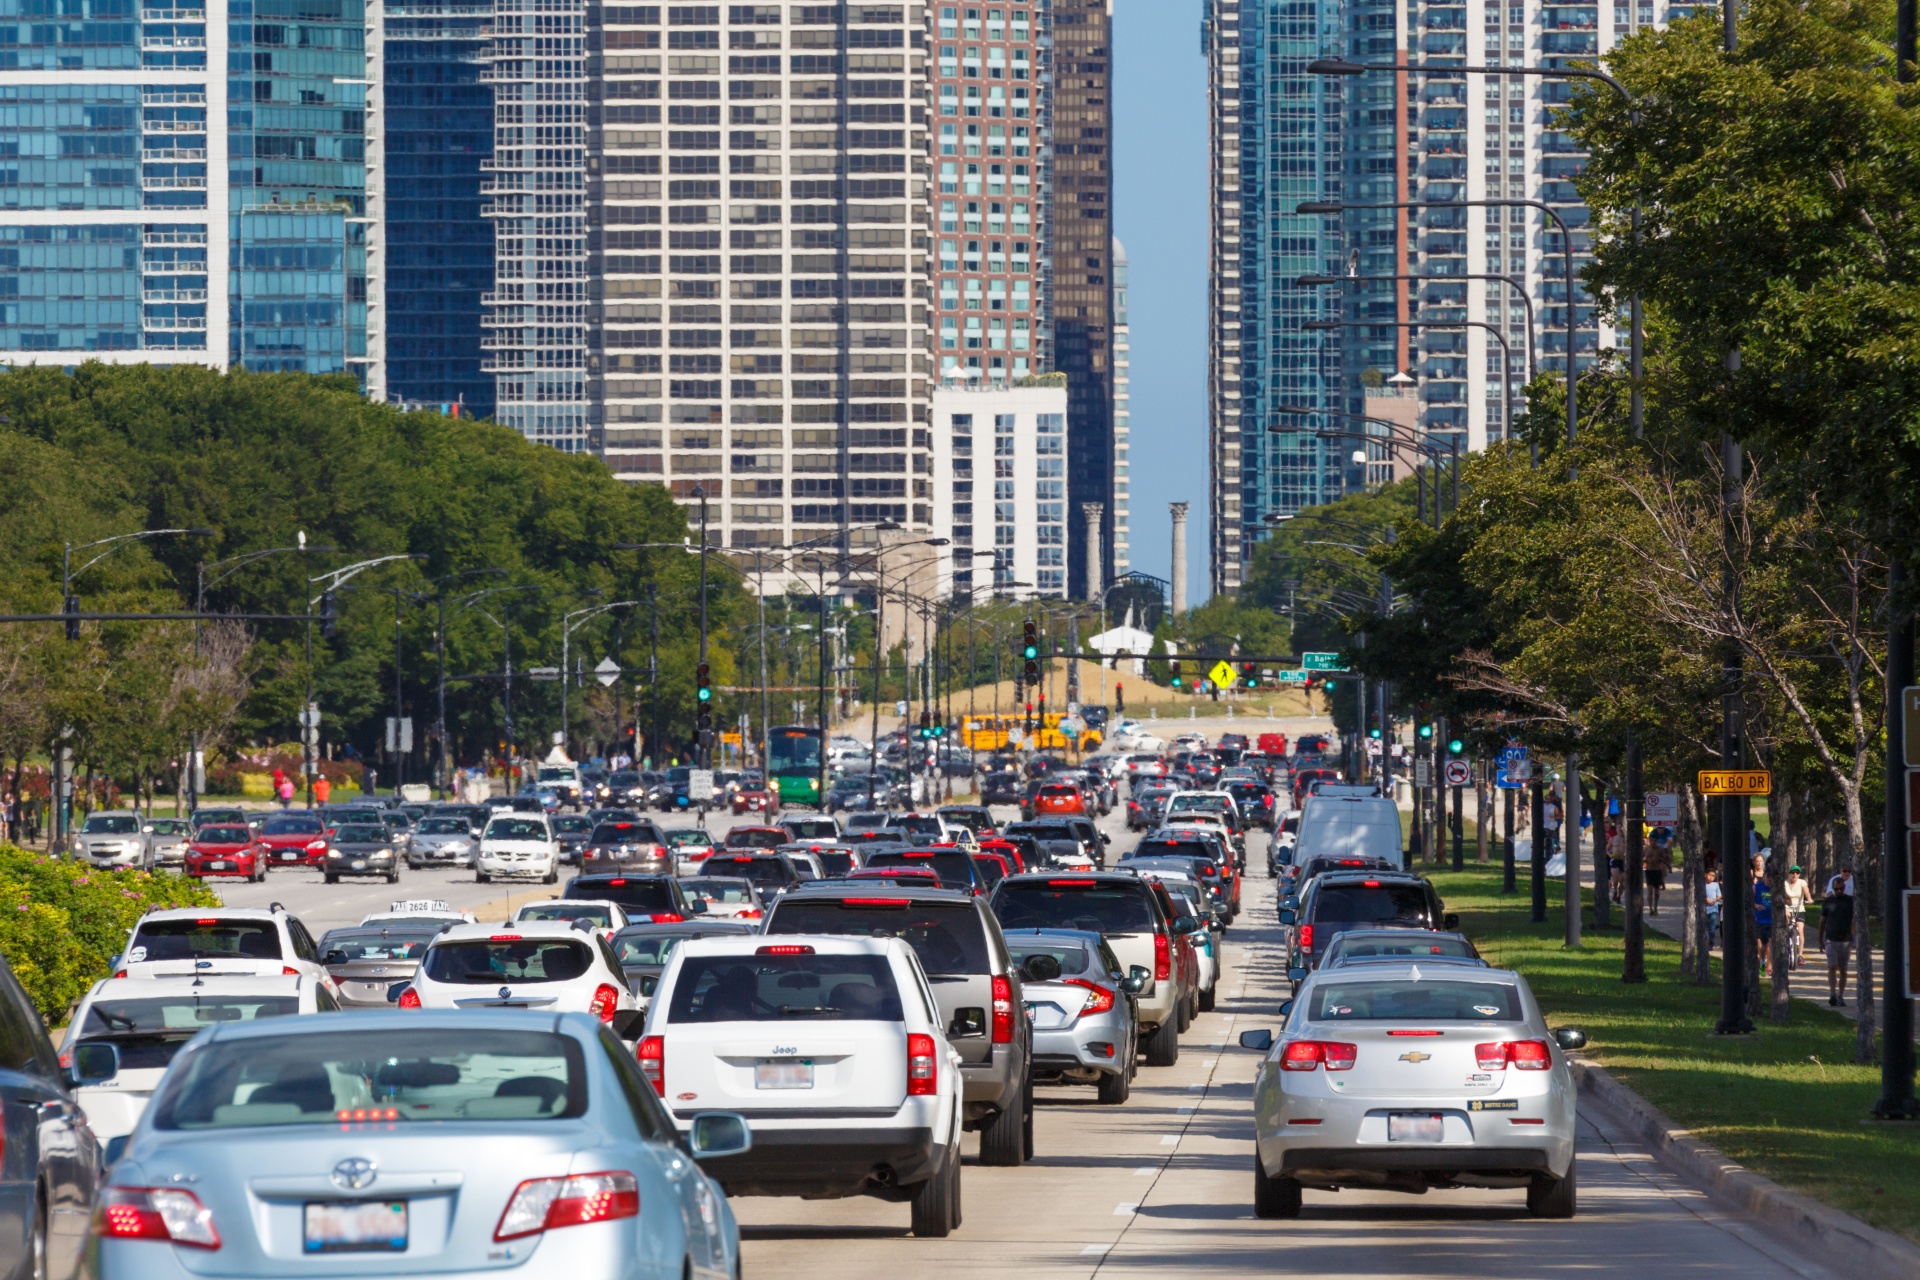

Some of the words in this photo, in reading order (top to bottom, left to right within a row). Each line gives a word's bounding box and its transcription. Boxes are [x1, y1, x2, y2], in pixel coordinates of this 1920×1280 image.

[1704, 776, 1743, 788] BALBO
[1749, 776, 1765, 788] DR
[409, 902, 428, 911] 2626
[772, 1045, 797, 1055] Jeep
